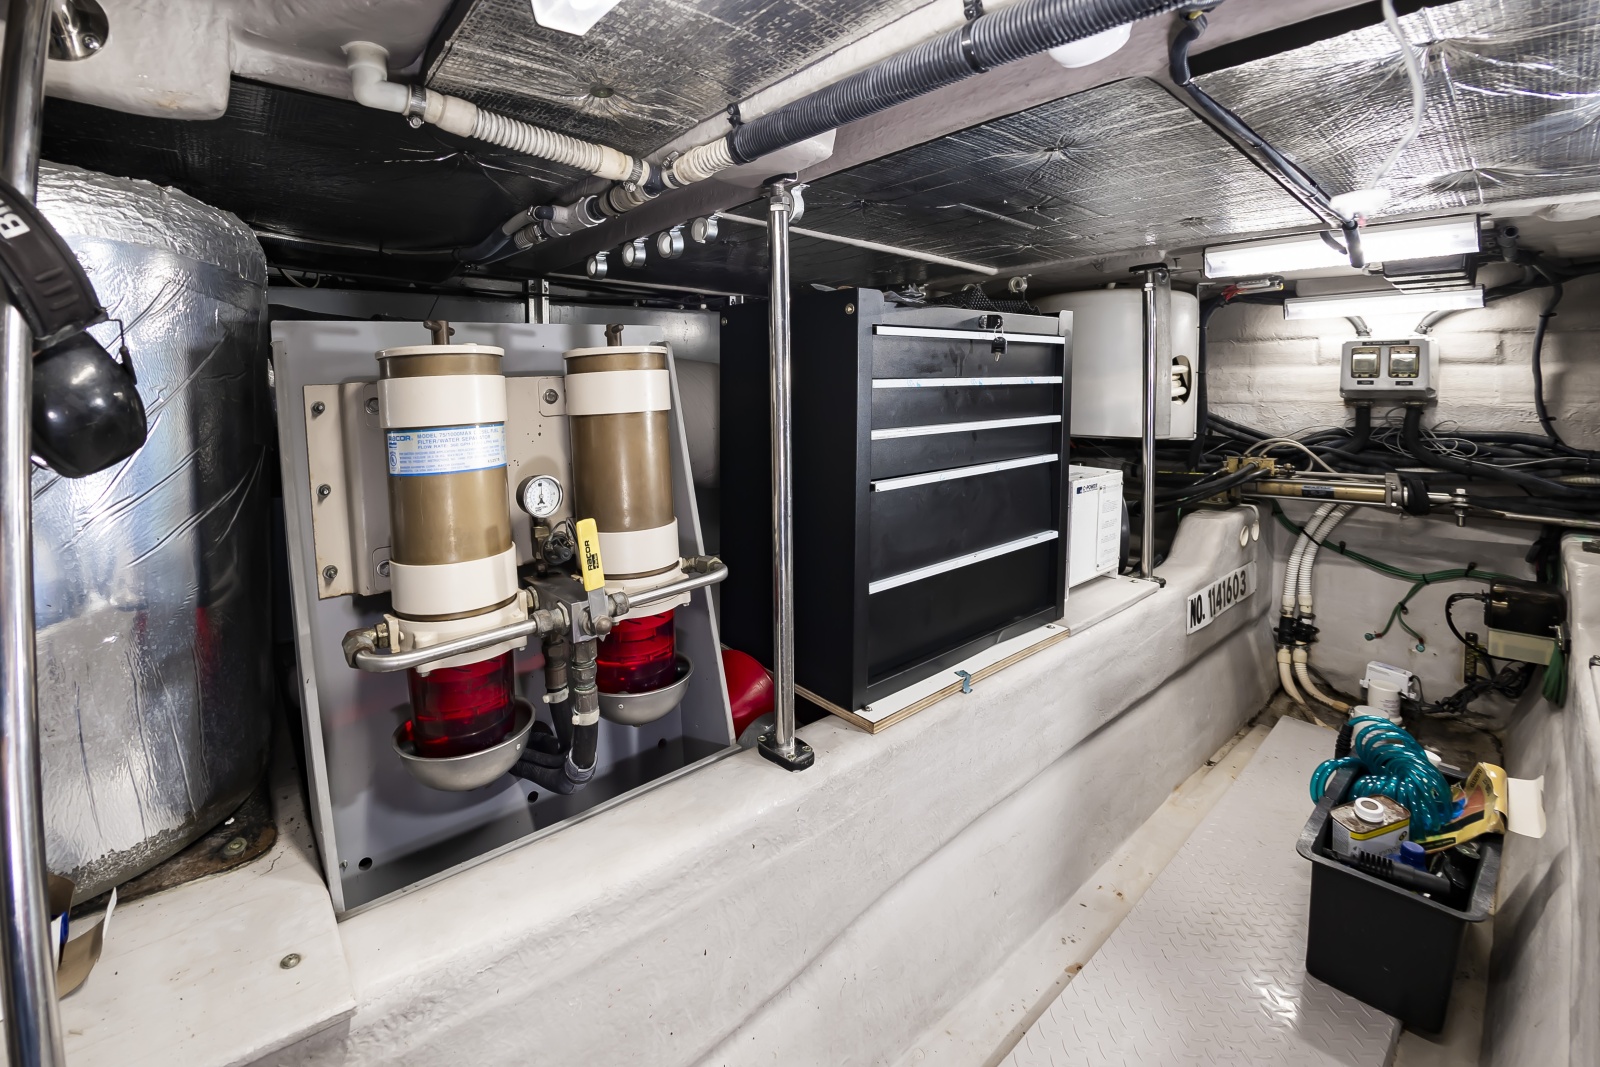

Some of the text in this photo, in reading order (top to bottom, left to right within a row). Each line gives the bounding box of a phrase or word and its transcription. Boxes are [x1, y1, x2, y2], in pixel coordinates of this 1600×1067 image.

[585, 540, 593, 571] RACOR
[1190, 570, 1247, 628] NO. 1141603
